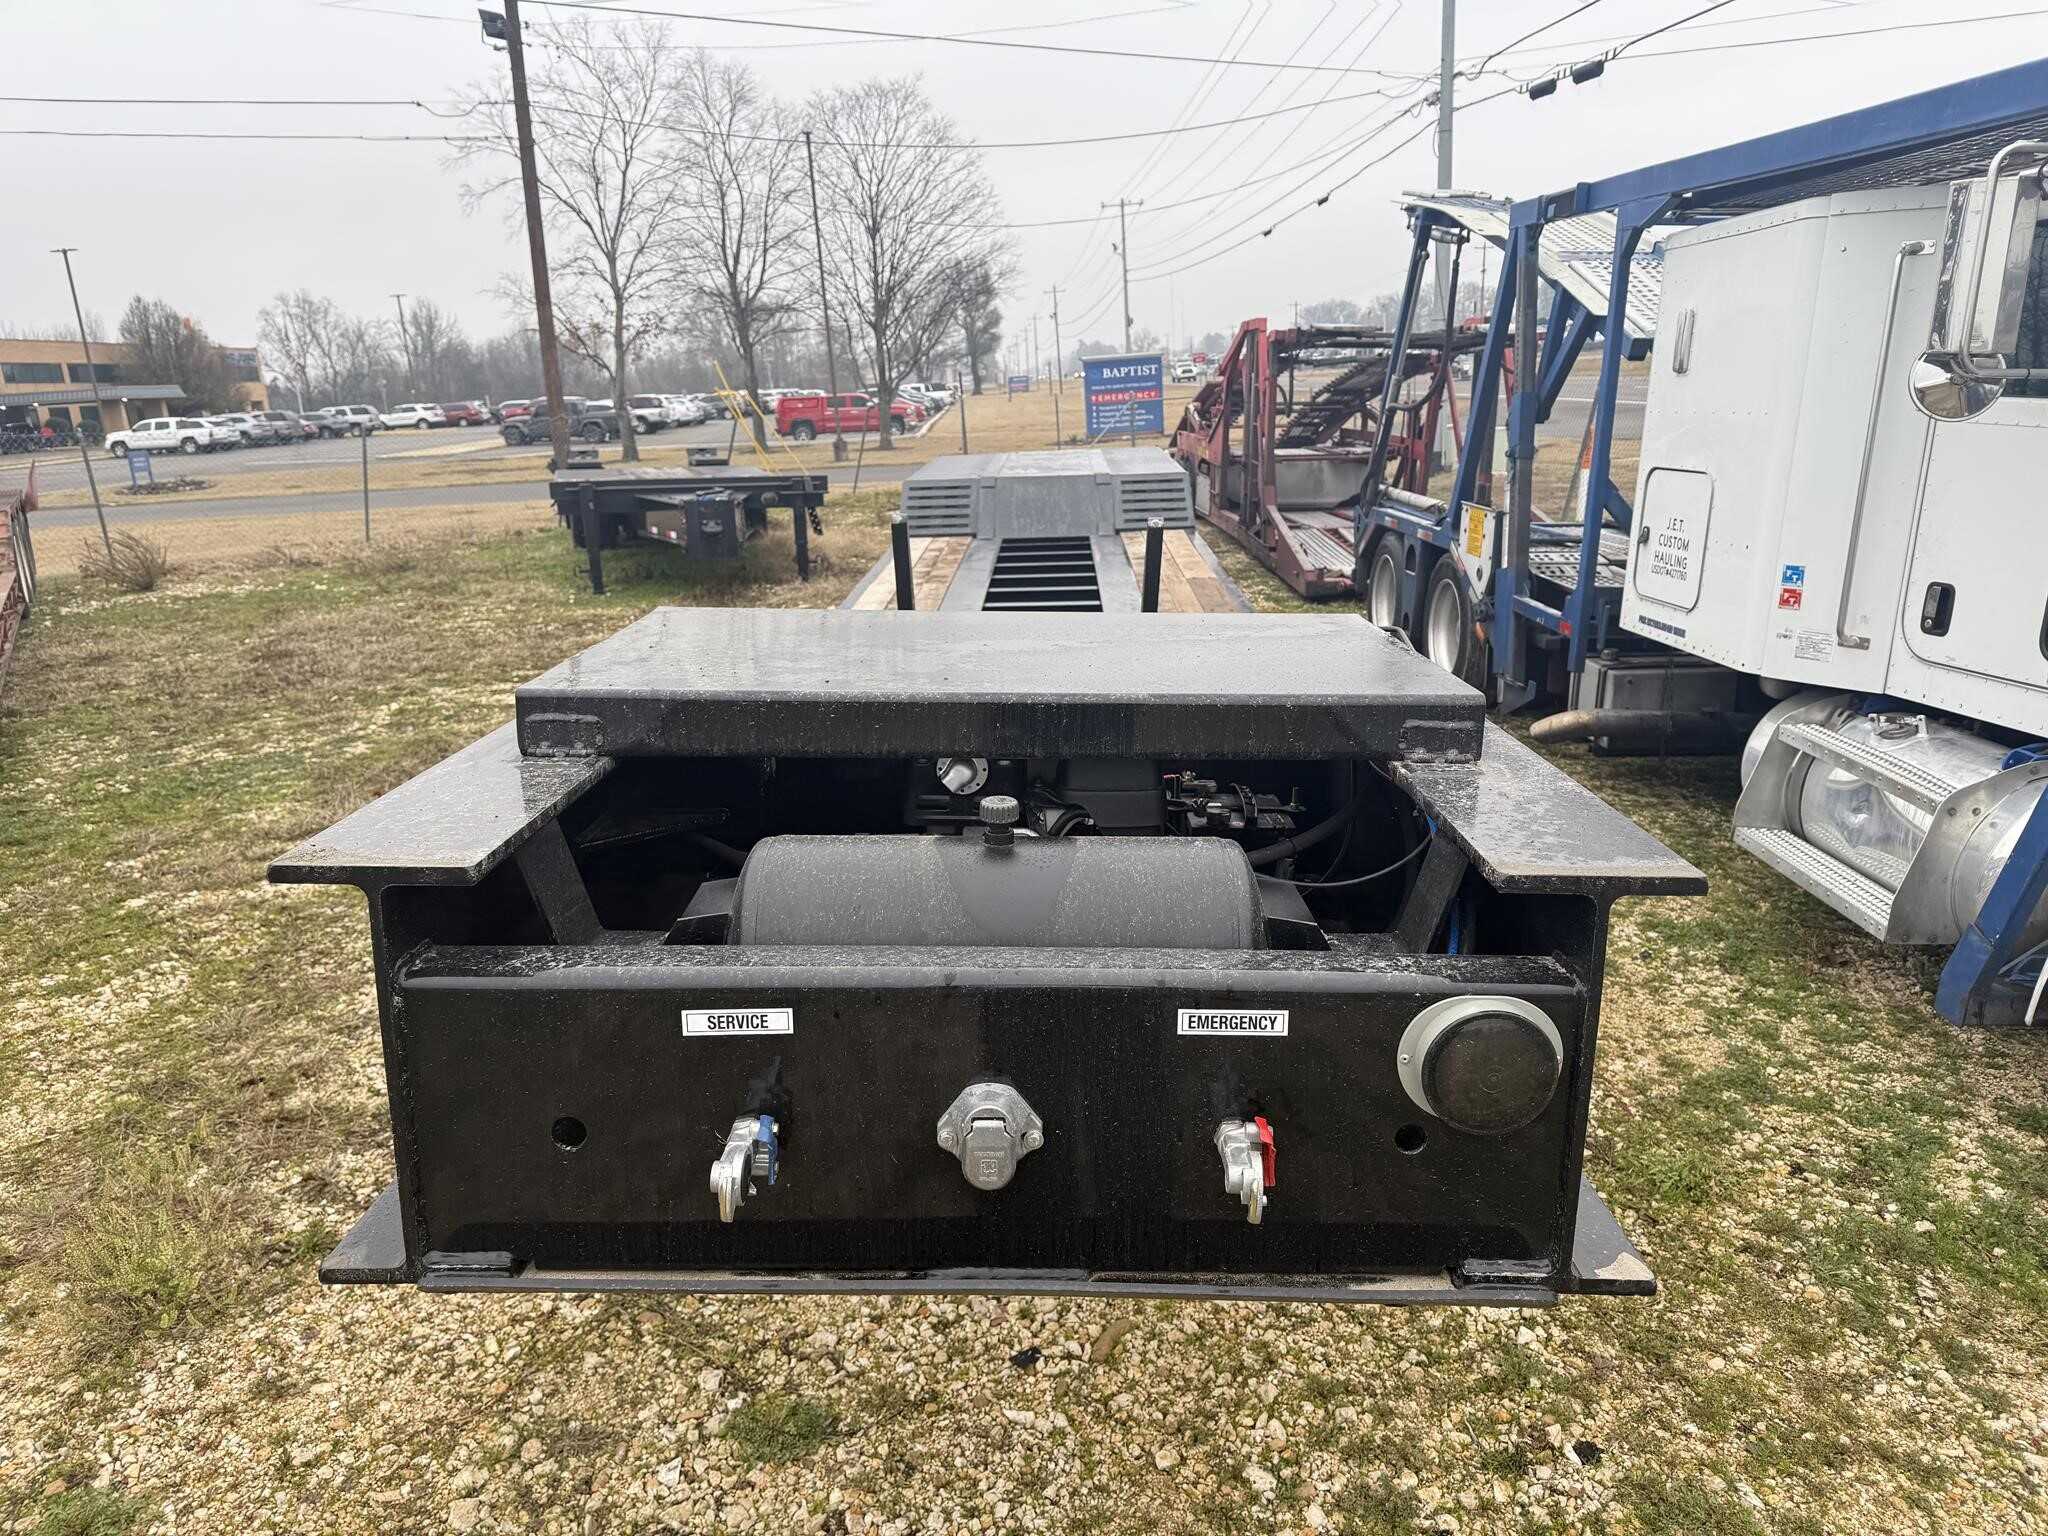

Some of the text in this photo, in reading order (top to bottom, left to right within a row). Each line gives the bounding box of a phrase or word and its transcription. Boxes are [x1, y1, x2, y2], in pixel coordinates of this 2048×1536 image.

[1102, 364, 1158, 379] BAPTIST
[1666, 516, 1685, 534] J.E.T.
[1658, 533, 1690, 552] CUSTOM
[1653, 550, 1688, 570] HAULING
[707, 1014, 769, 1030] SERVICE
[1188, 1014, 1278, 1031] EMERGENCY
